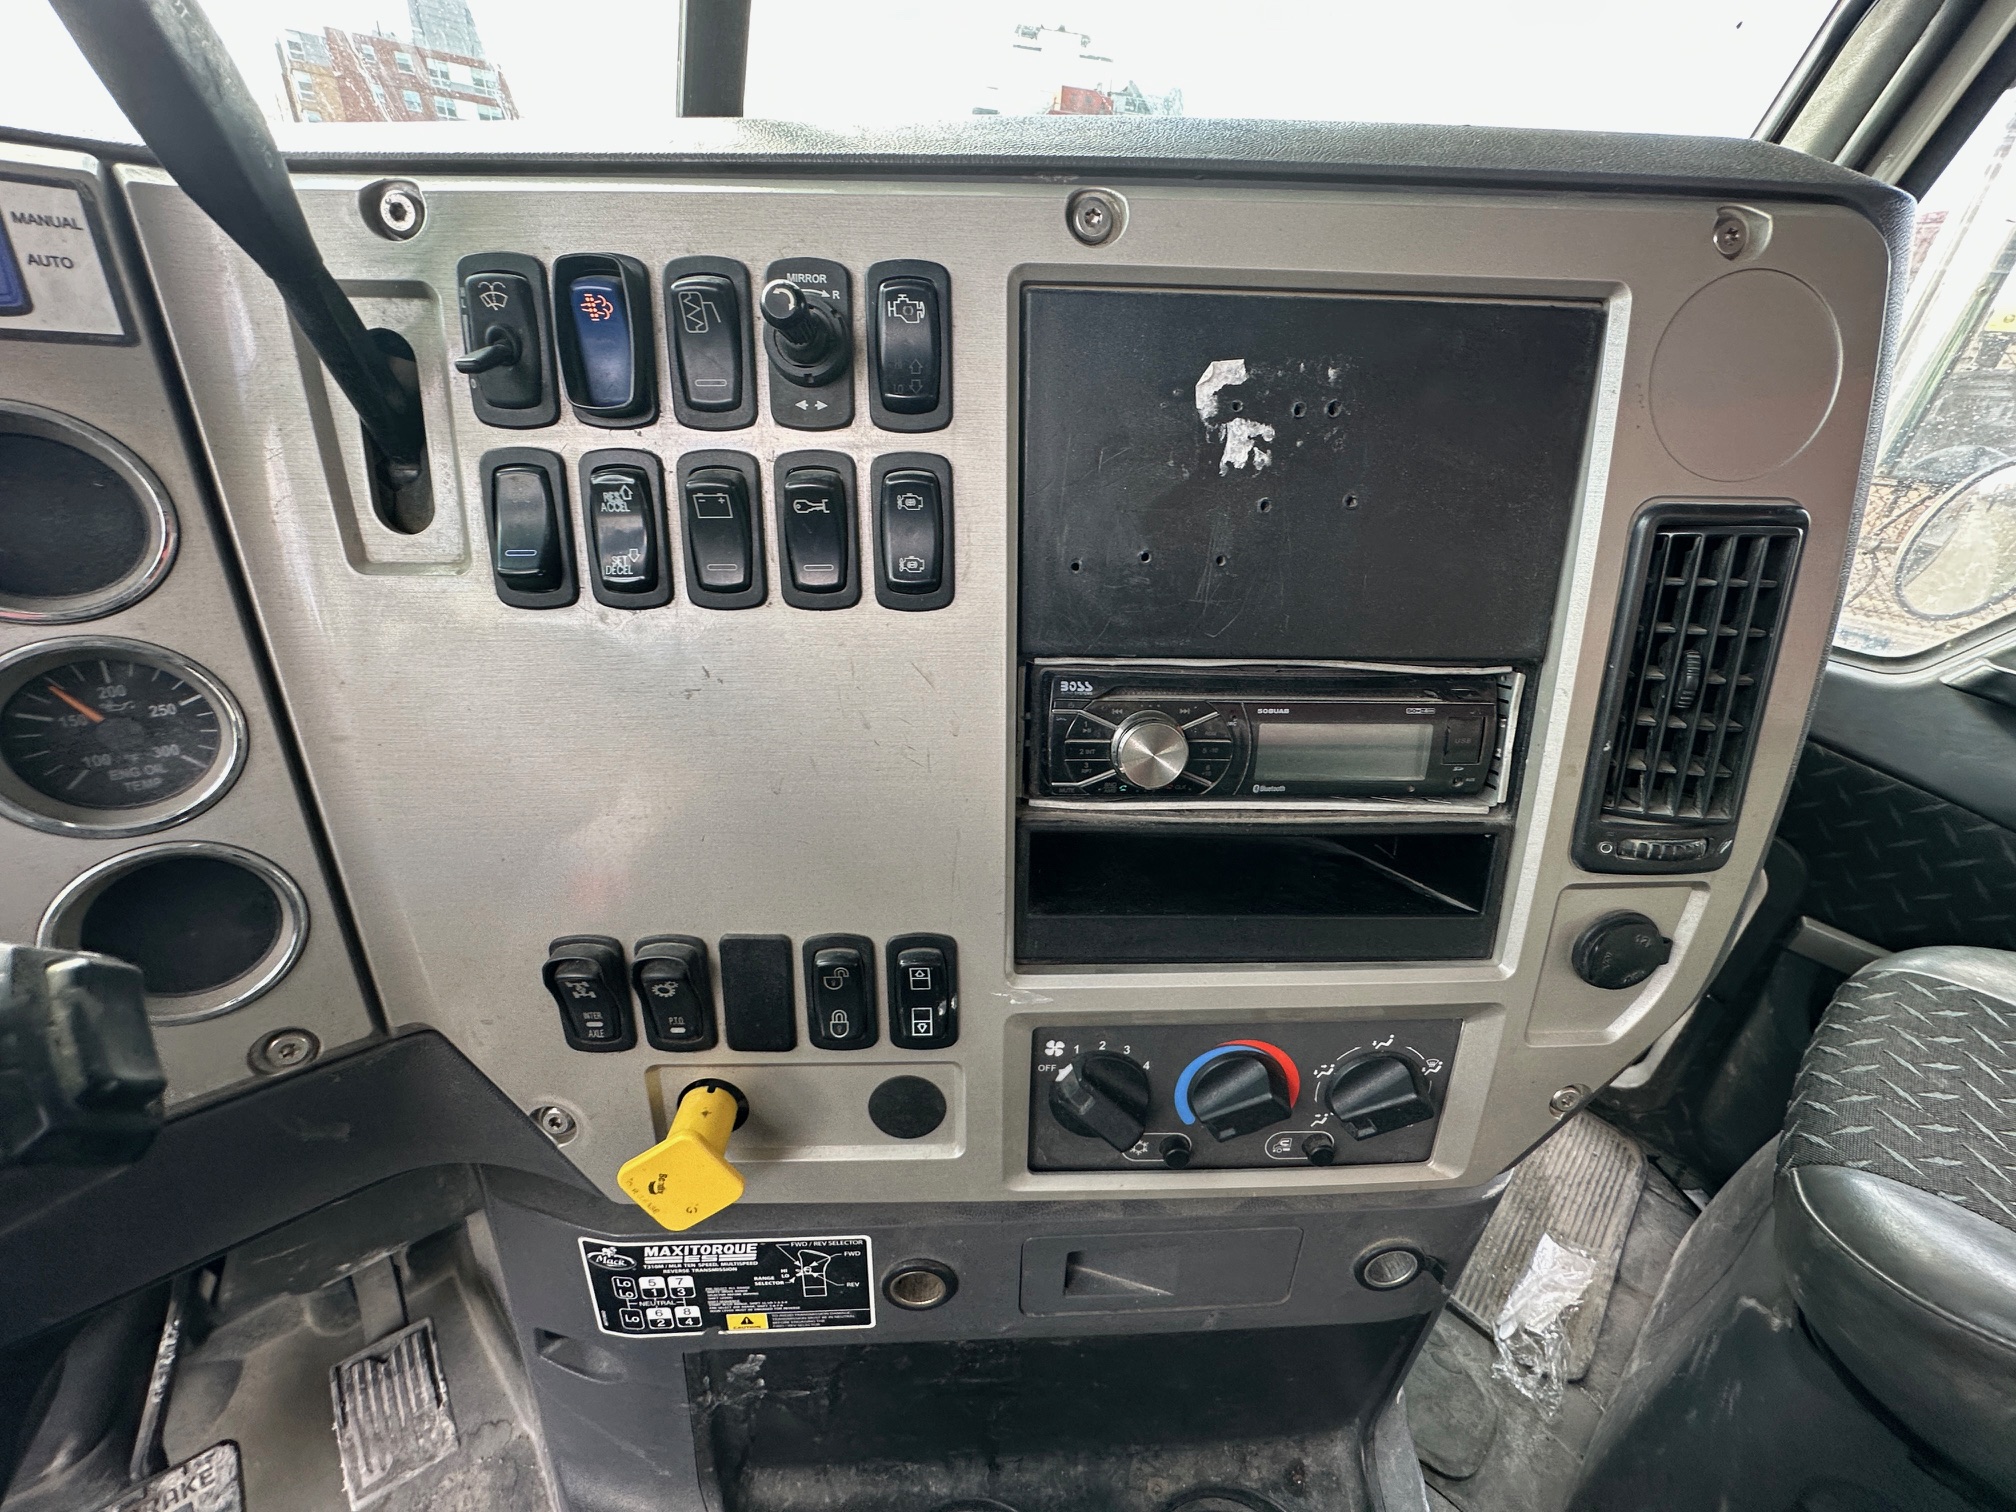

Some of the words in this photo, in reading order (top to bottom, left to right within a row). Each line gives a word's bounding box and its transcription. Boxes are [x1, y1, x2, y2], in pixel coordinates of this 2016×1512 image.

[10, 210, 84, 231] MANUAL
[27, 253, 74, 269] AUTO
[786, 272, 828, 284] MIRROR
[832, 290, 840, 300] R
[602, 491, 623, 503] RES
[601, 502, 631, 512] ACCEL
[611, 555, 628, 567] SET
[605, 565, 634, 575] DECEL
[96, 684, 127, 699] 200
[1060, 681, 1093, 692] BOSS
[148, 703, 178, 718] 250
[58, 714, 88, 728] 150
[152, 744, 181, 758] 300
[82, 753, 112, 768] 100
[123, 777, 163, 793] TEMP
[583, 1011, 603, 1020] INTER
[587, 1029, 605, 1038] AXLE
[1074, 1045, 1080, 1054] 1
[1099, 1041, 1107, 1051] 2
[1123, 1045, 1131, 1055] 3
[1037, 1064, 1057, 1072] OFF
[1142, 1061, 1150, 1070] 4
[644, 1243, 758, 1257] MAXITORQUE
[595, 1254, 627, 1267] Mack
[616, 1279, 631, 1287] Lo
[648, 1279, 657, 1287] 5
[675, 1278, 684, 1286] 7
[619, 1289, 634, 1298] Lo
[676, 1288, 686, 1296] 3
[625, 1314, 640, 1322] Lo
[685, 1318, 694, 1326] 4
